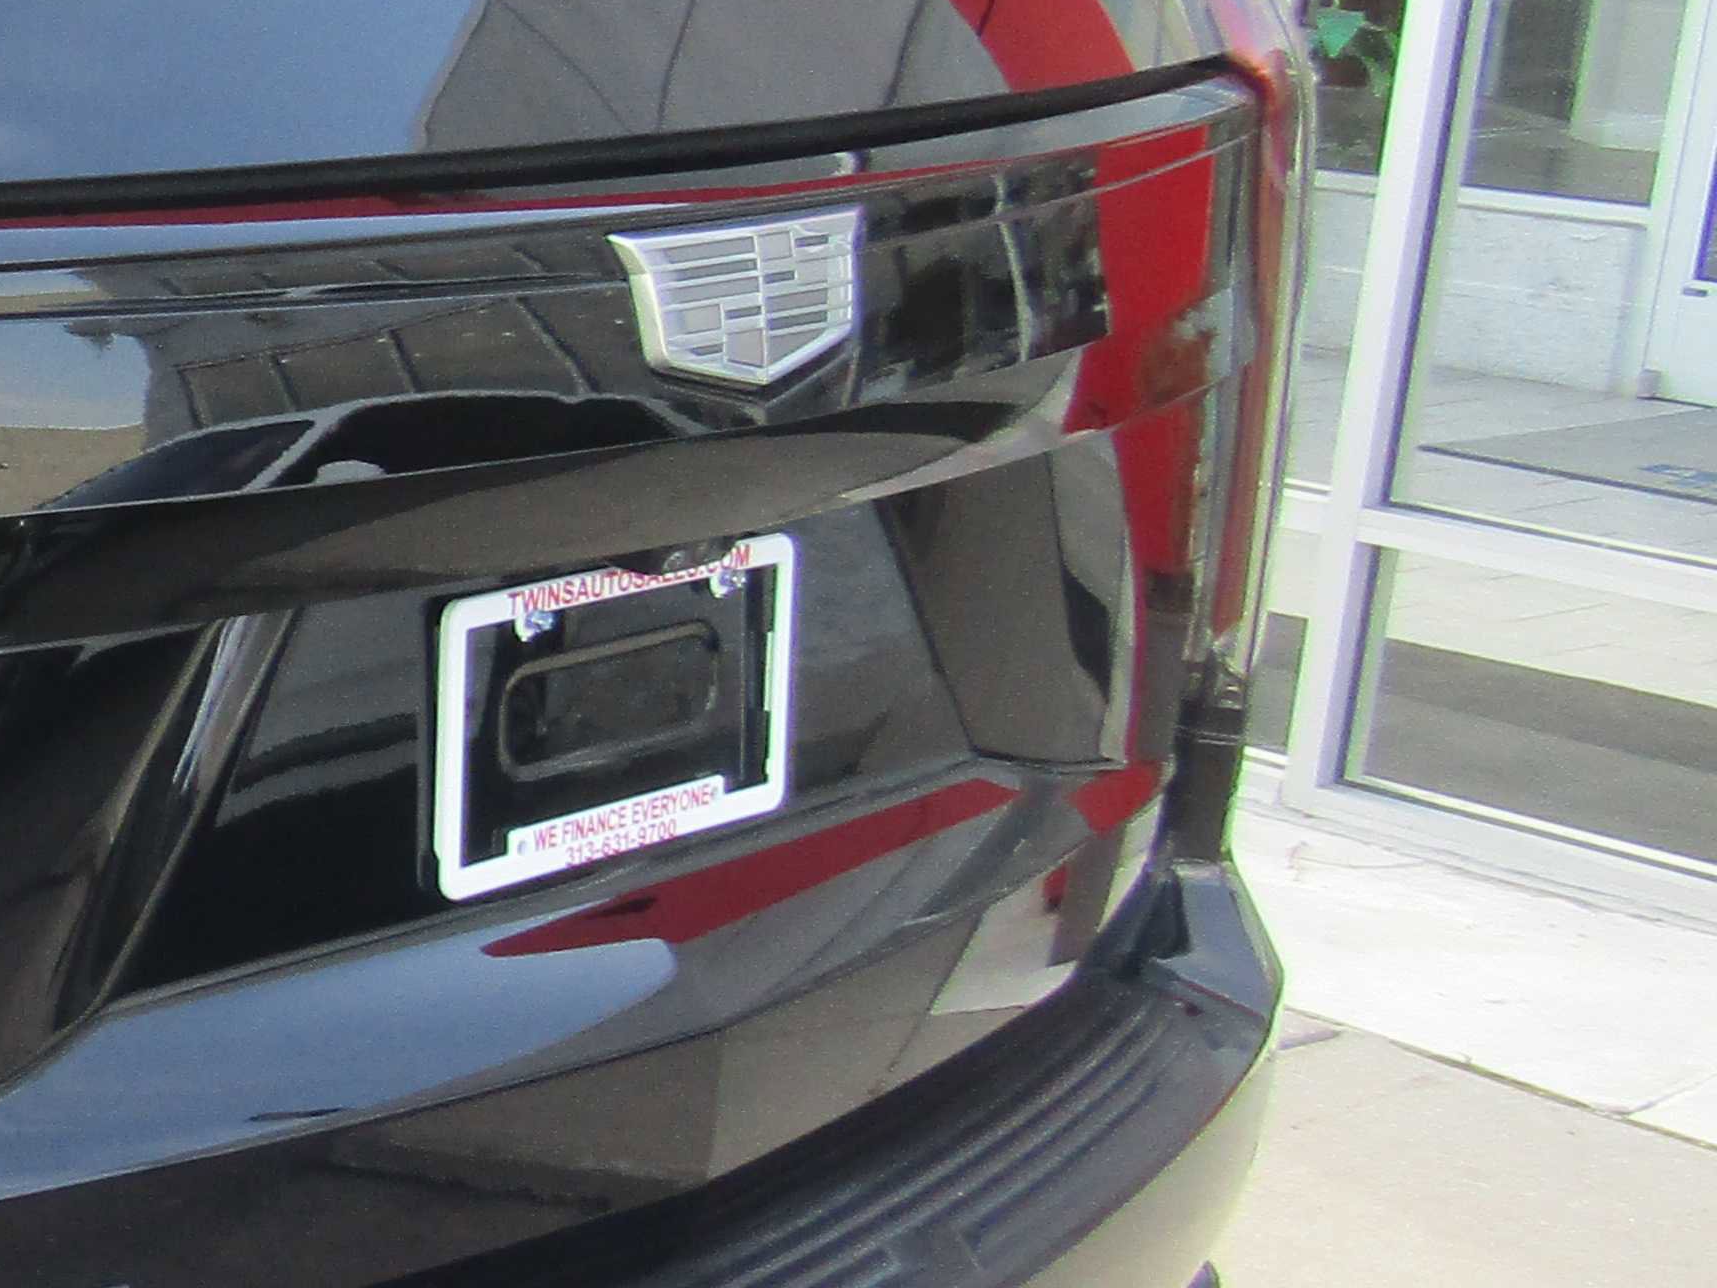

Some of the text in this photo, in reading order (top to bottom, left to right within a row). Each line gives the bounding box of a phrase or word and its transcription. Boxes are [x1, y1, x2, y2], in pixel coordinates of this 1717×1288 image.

[534, 783, 711, 852] WE FINANCE EVERYONE
